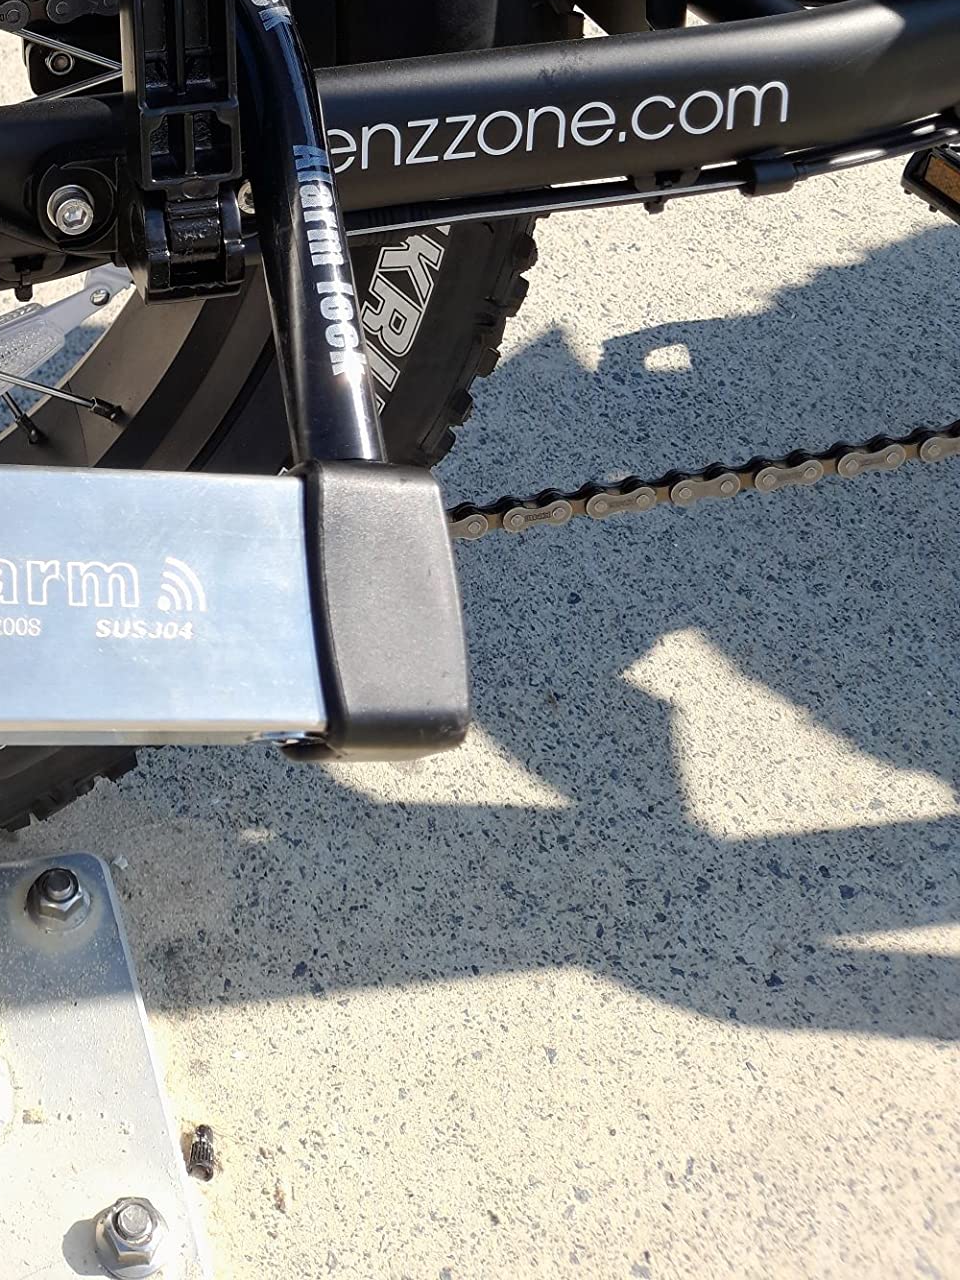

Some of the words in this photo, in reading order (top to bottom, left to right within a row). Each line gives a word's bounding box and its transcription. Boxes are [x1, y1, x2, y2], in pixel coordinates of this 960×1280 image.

[326, 80, 790, 174] enzzone.com
[292, 144, 345, 267] Alarm
[316, 281, 368, 376] lock
